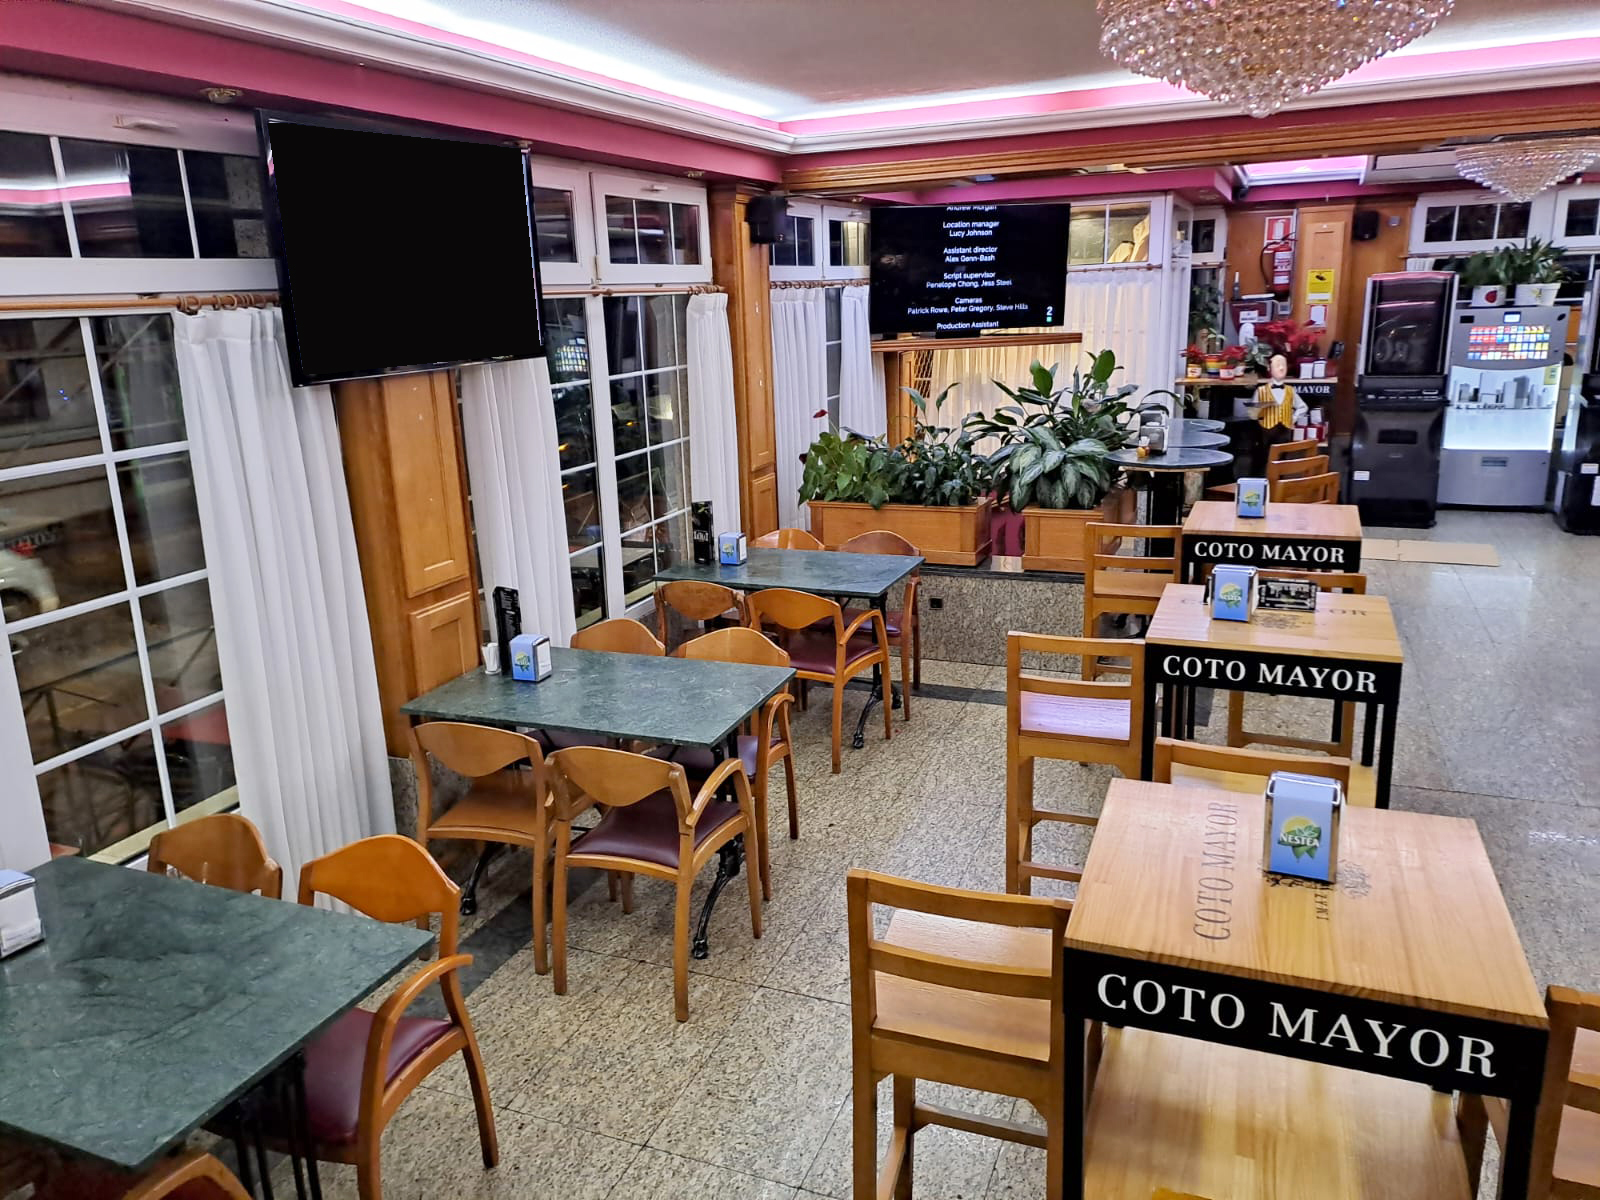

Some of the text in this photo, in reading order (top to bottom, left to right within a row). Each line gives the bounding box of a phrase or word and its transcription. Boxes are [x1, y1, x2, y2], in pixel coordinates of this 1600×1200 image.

[942, 220, 1000, 229] Location manager
[949, 229, 993, 238] Lucy Johnson
[943, 245, 998, 254] Assistant director
[944, 255, 960, 263] Alex
[943, 271, 997, 280] Script supervisor
[907, 307, 929, 315] Patrick
[951, 305, 968, 313] Peter
[1046, 306, 1053, 316] 2
[936, 320, 999, 330] Production Assistant
[1194, 541, 1345, 563] COTO MAYOR
[1163, 655, 1377, 694] COTO MAYOR
[1279, 832, 1320, 848] NESTEA
[1193, 802, 1240, 940] COTO MAYOR
[1097, 973, 1497, 1079] COTO MAYOR
